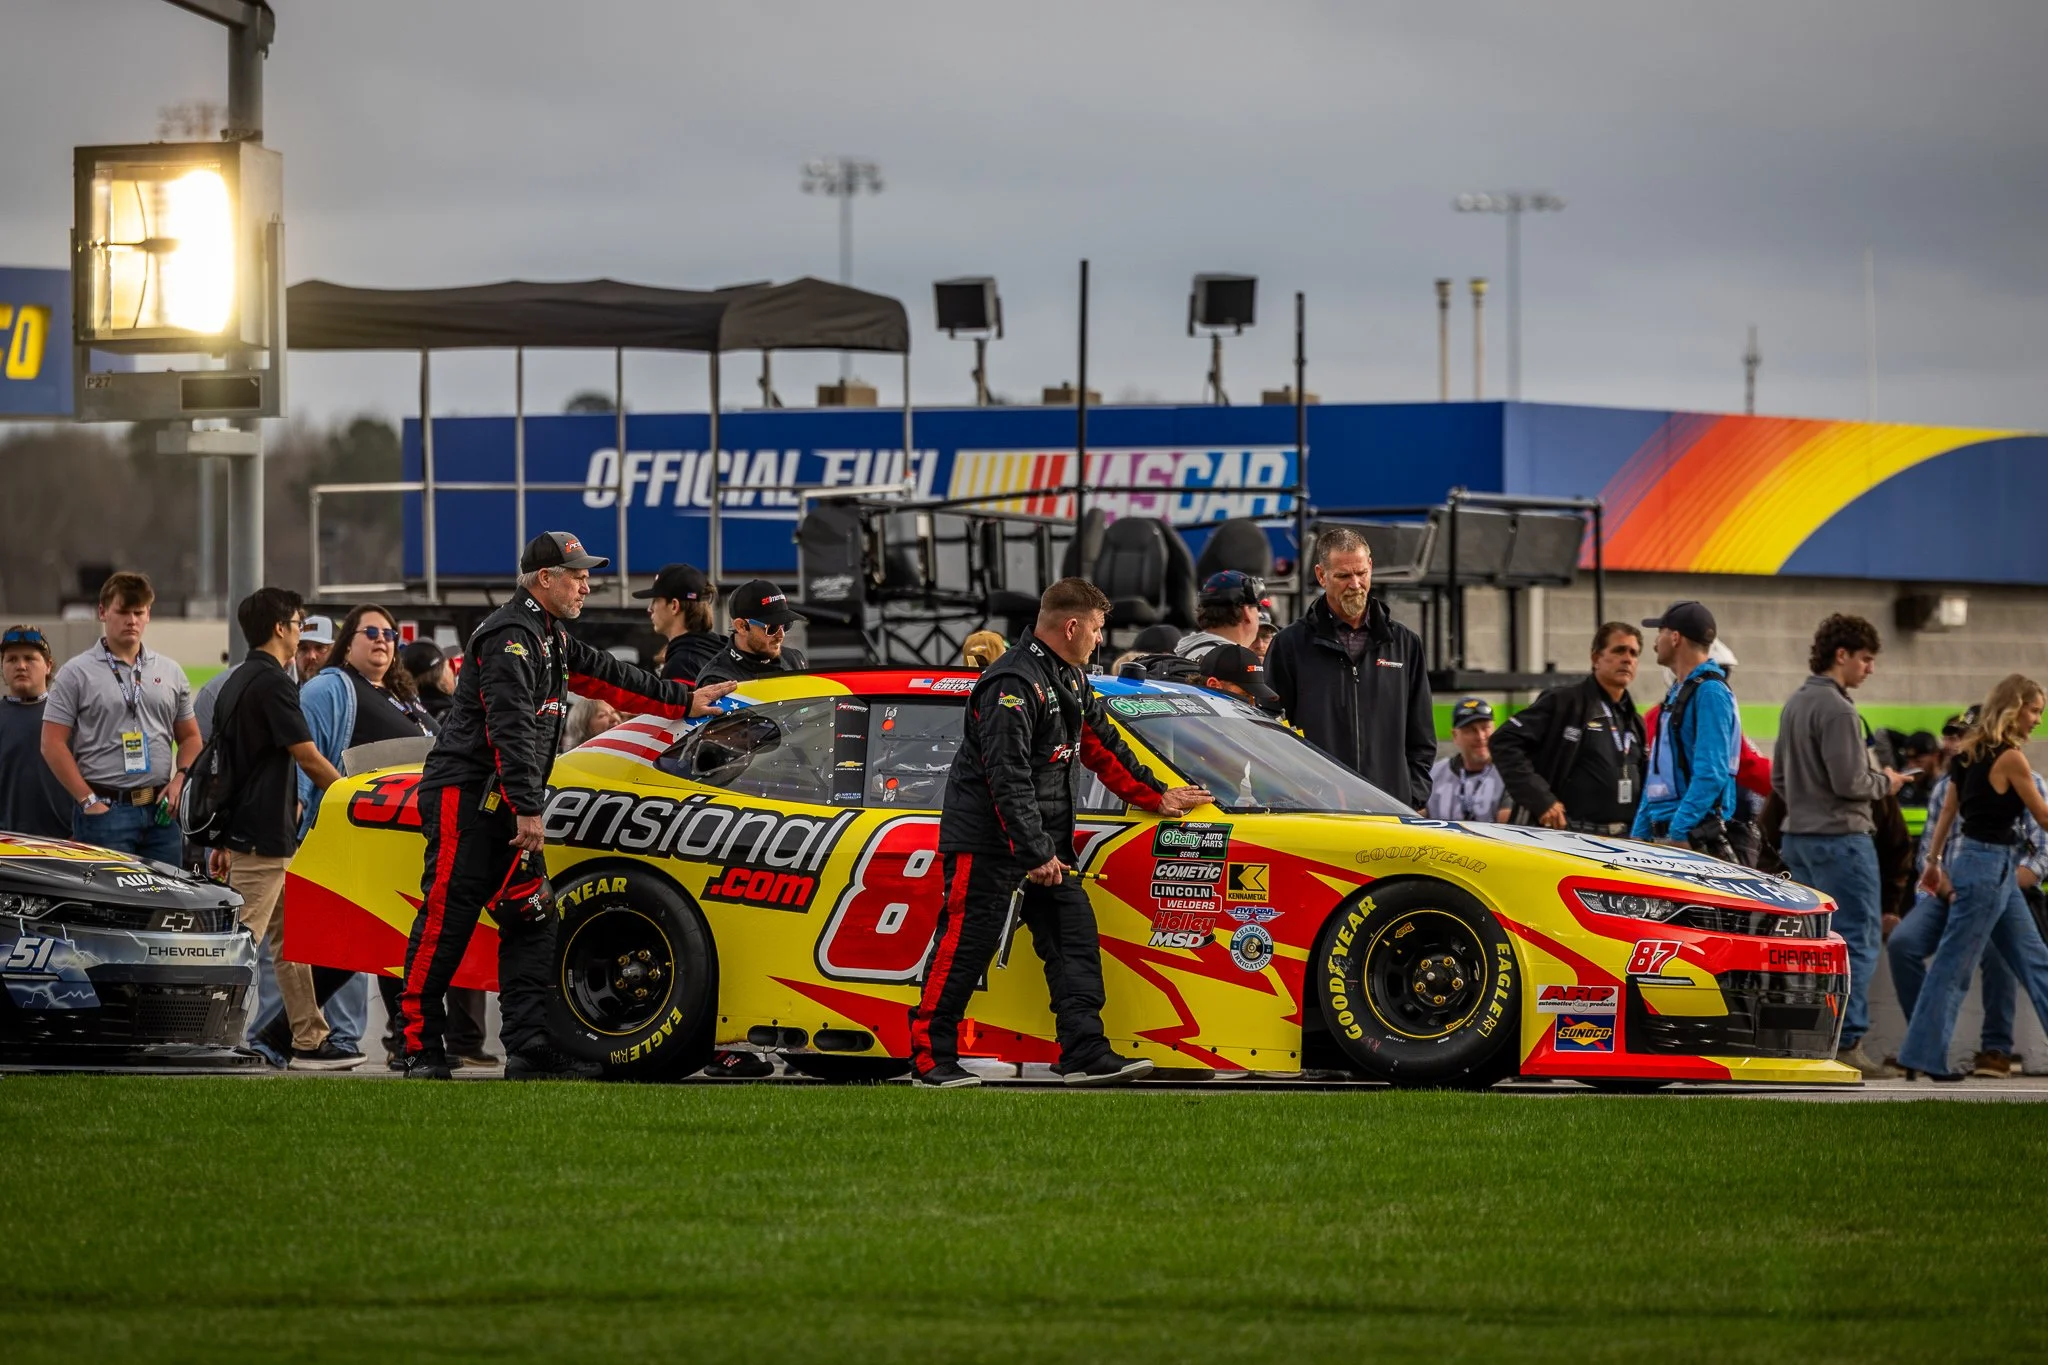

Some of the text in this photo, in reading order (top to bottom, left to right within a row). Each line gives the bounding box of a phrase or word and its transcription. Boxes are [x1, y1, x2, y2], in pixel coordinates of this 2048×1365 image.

[87, 377, 111, 388] P27
[583, 449, 800, 508] OFFICIAL
[525, 599, 541, 612] 87
[1029, 643, 1045, 657] 87
[1161, 830, 1201, 848] O'Reilly
[1201, 840, 1223, 848] PARTS
[1356, 845, 1488, 873] GOODYEAR
[1156, 864, 1221, 879] COMETIC
[568, 877, 628, 906] YEAR
[710, 867, 813, 906] .com
[1154, 885, 1210, 898] LINCOLN
[1167, 899, 1215, 910] WELDERS
[1227, 892, 1267, 900] KENNAMETAL
[1151, 911, 1216, 938] Holley
[1148, 931, 1205, 948] MSD
[1236, 926, 1270, 942] CHAMPION
[6, 937, 55, 972] 51
[148, 946, 226, 957] CHEVROLET
[1626, 939, 1683, 976] 87
[1769, 949, 1832, 967] CHEVROLET
[1233, 952, 1270, 970] IRRIGATION
[1328, 895, 1377, 1040] GOODYEAR
[1489, 943, 1512, 1018] EAGLE
[1539, 986, 1615, 1001] ARP
[630, 1006, 683, 1062] EAGLE
[1558, 1028, 1611, 1039] SUNOCO
